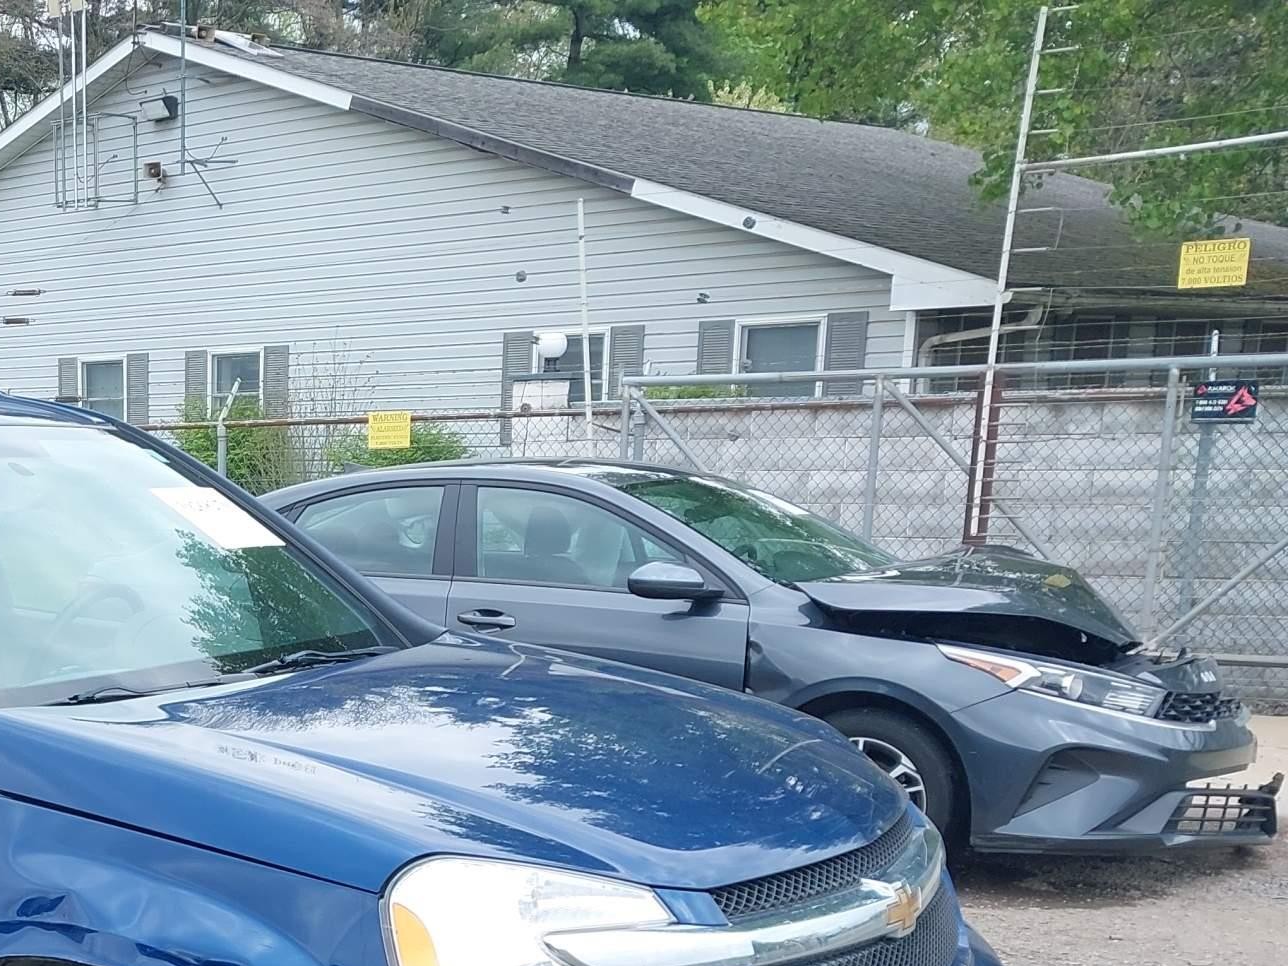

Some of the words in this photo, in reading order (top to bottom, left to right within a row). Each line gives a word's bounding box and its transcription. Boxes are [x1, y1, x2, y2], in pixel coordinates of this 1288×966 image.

[1185, 240, 1247, 253] PELIGRO
[1193, 255, 1205, 265] NO
[1208, 254, 1236, 264] TOQUE
[1204, 274, 1244, 284] VOLTIOS
[372, 413, 408, 422] WARNING
